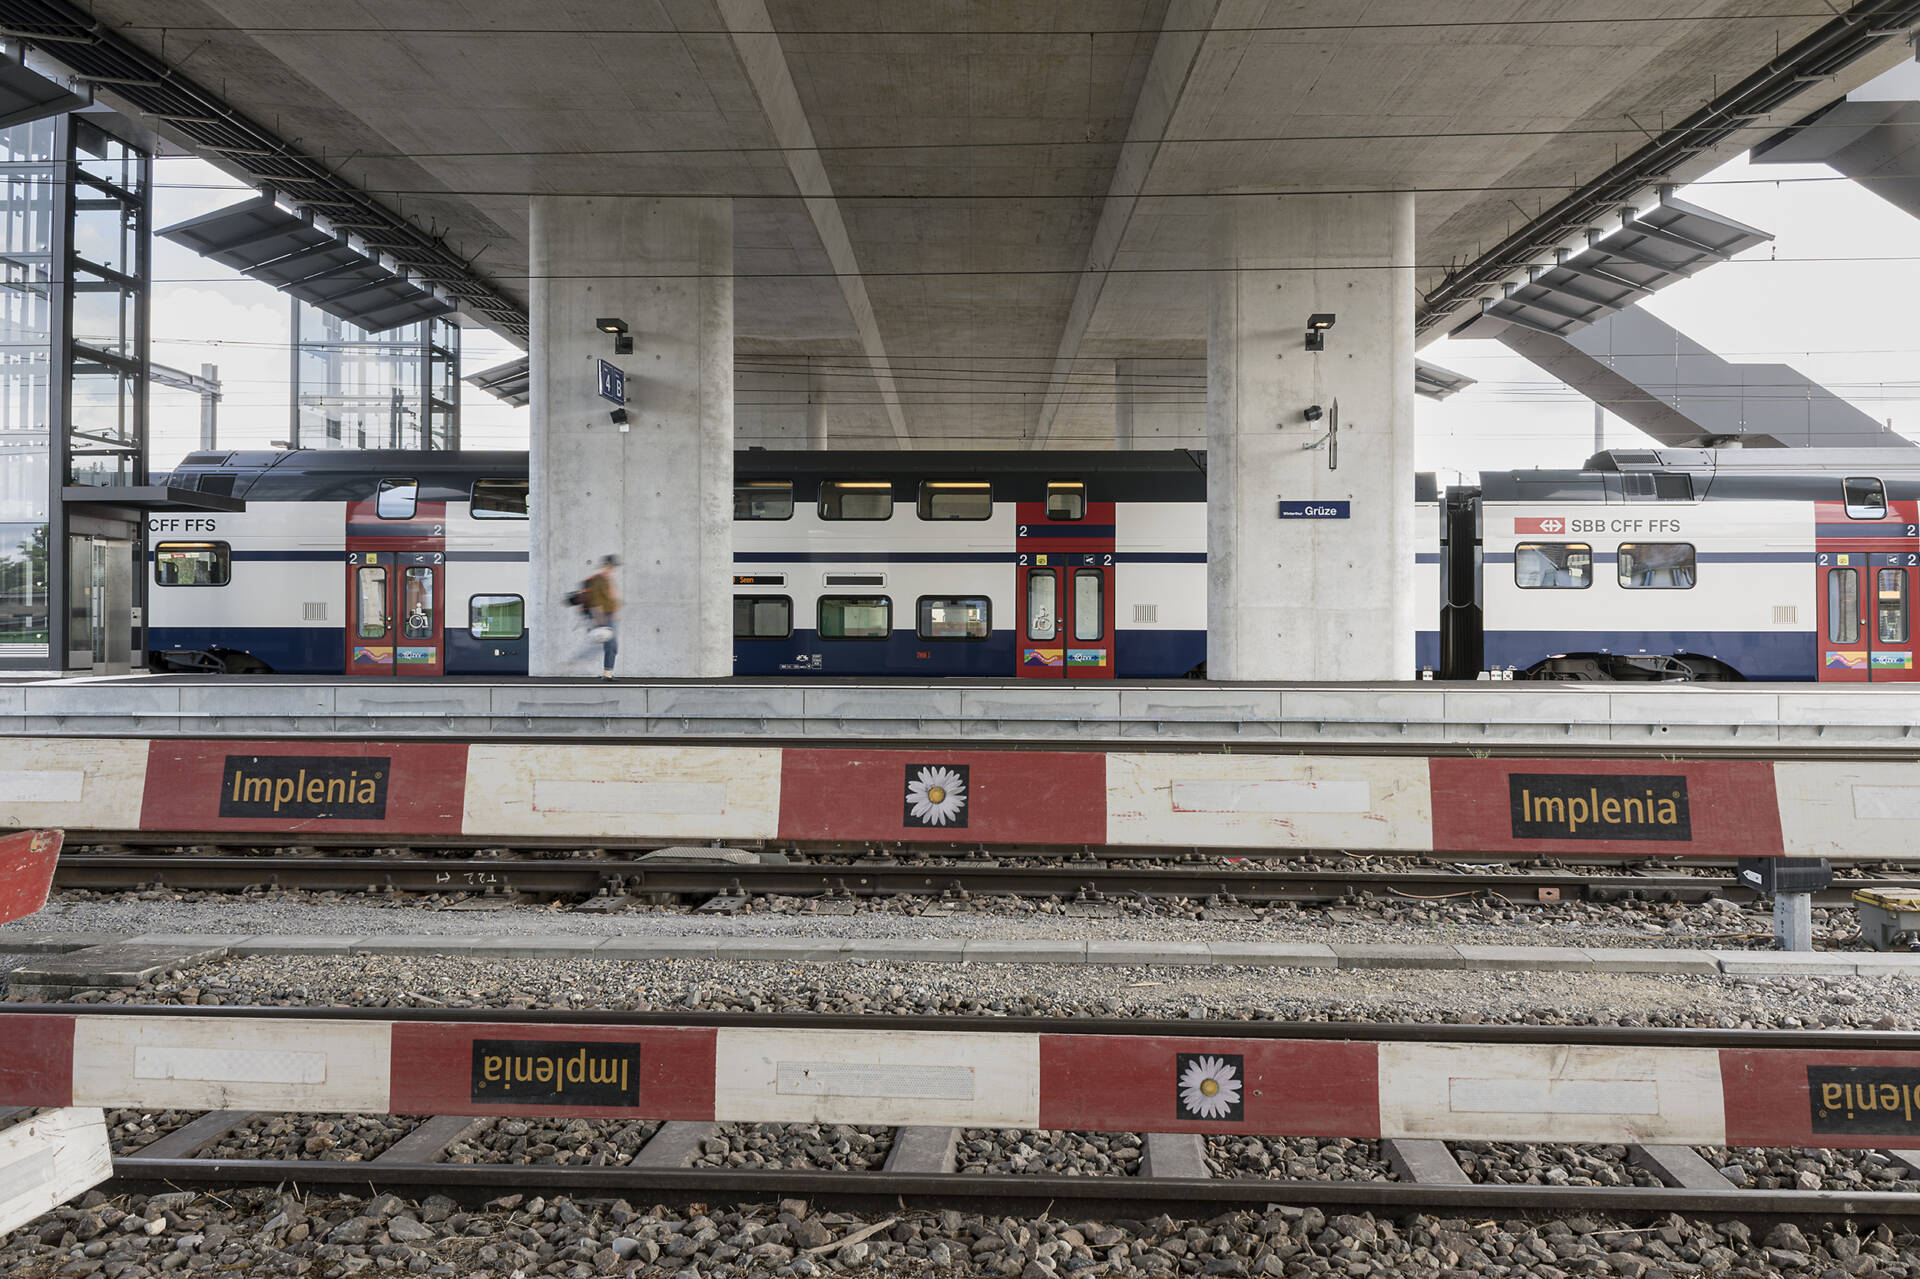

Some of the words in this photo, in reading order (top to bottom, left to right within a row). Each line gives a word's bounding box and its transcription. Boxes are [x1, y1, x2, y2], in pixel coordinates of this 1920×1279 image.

[1304, 506, 1337, 516] Grüze
[148, 519, 179, 532] CFF
[185, 519, 216, 532] FFS
[434, 524, 442, 536] 2
[1019, 525, 1028, 537] 2
[1571, 519, 1605, 533] SBB
[1610, 519, 1643, 533] CFF
[1648, 519, 1681, 533] FFS
[1907, 524, 1916, 536] 2
[349, 553, 358, 564] 2
[434, 553, 442, 564] 2
[1019, 554, 1028, 566] 2
[1104, 554, 1112, 566] 2
[1819, 554, 1829, 566] 2
[1908, 554, 1917, 566] 2
